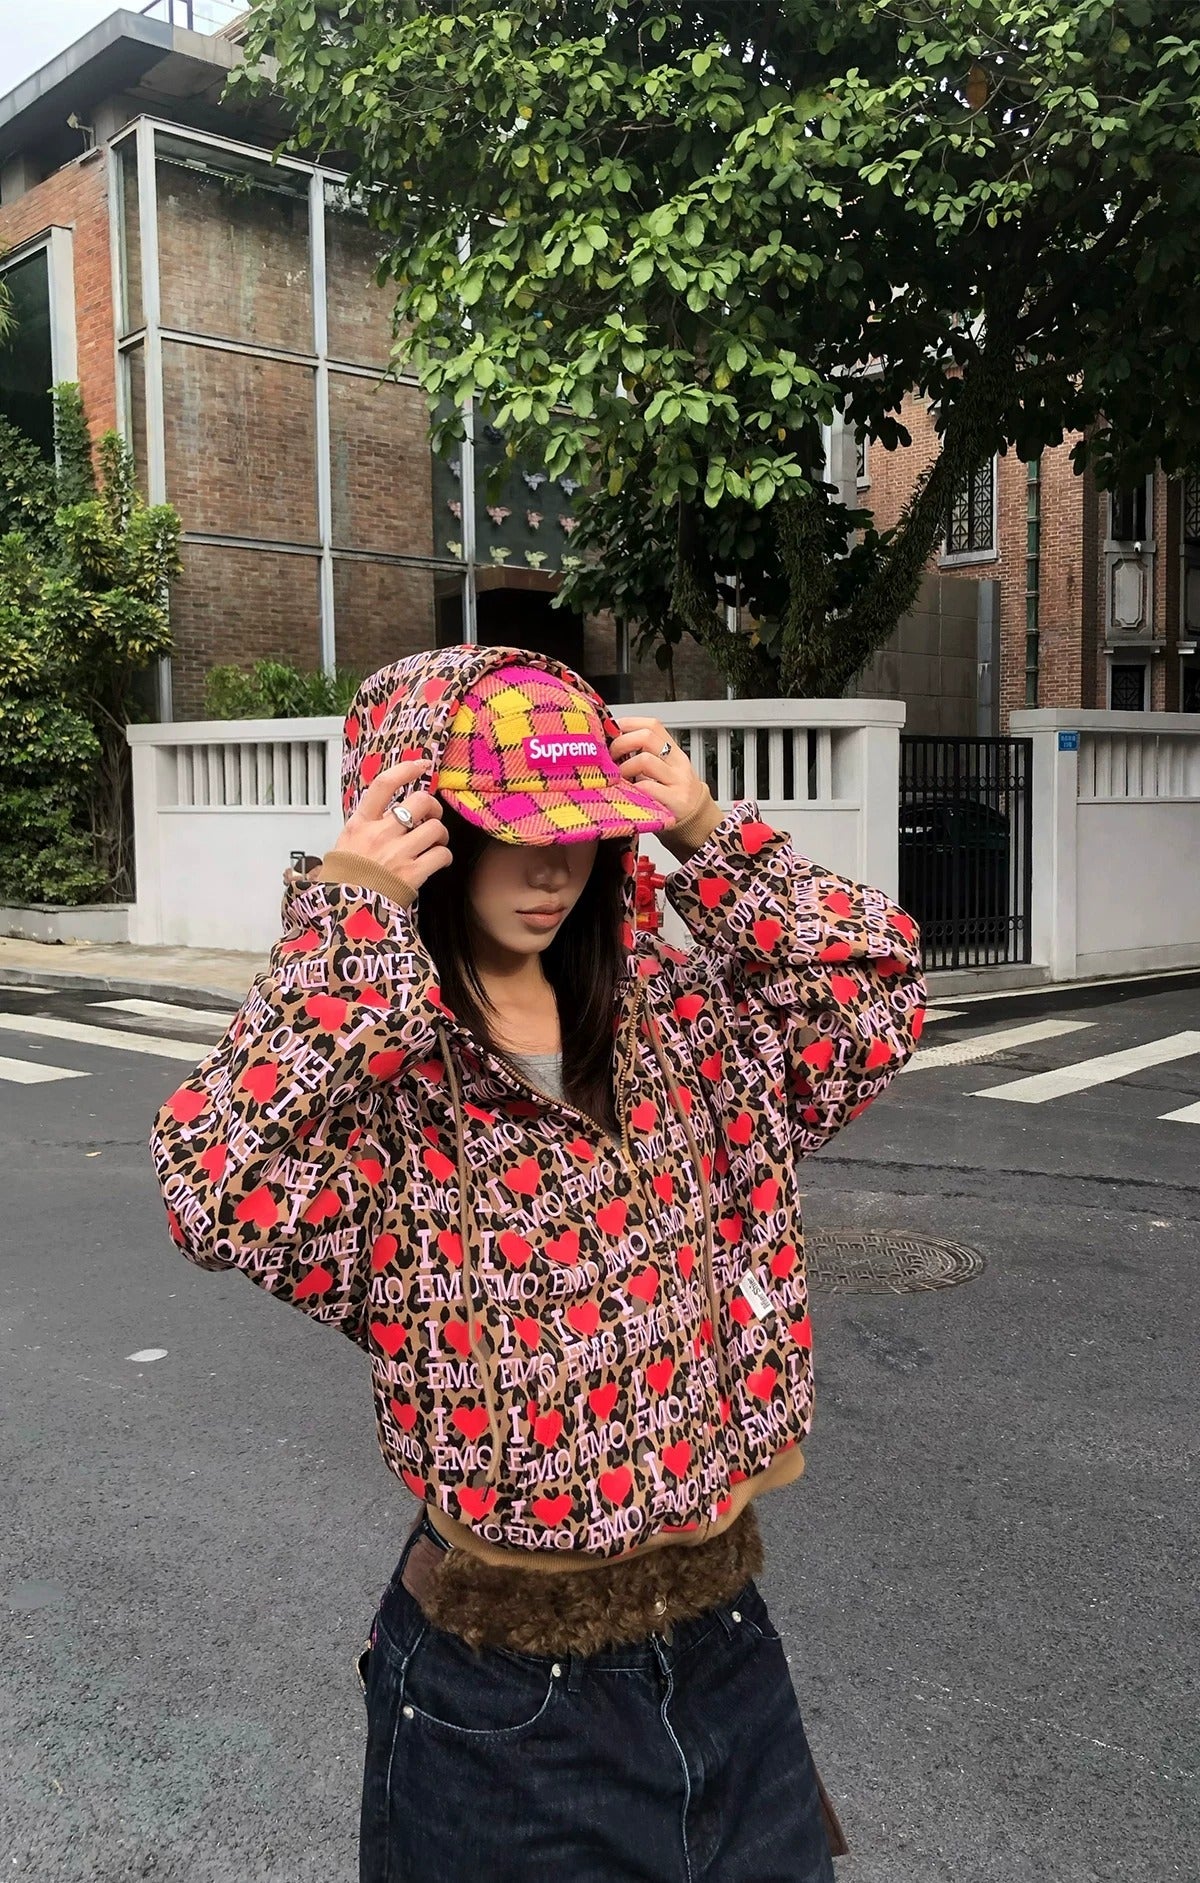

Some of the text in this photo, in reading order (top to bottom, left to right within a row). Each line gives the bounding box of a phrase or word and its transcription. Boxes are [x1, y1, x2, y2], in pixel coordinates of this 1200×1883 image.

[529, 738, 598, 763] Supreme
[713, 855, 744, 881] I
[767, 844, 793, 878] MO
[727, 878, 772, 932] EMO
[388, 915, 409, 941] I
[824, 924, 855, 941] I
[342, 953, 417, 984] EMO
[761, 978, 799, 1007] EM
[891, 978, 927, 1013] MO
[337, 1013, 376, 1050] I
[400, 1016, 438, 1058] MO
[657, 1014, 681, 1042] I
[886, 1027, 907, 1058] I
[269, 1026, 335, 1090] EMO
[833, 1038, 852, 1068] I
[266, 1081, 304, 1120] I
[709, 1078, 735, 1116] MO
[812, 1080, 849, 1101] EM
[857, 1068, 900, 1099] MO
[759, 1091, 781, 1123] I
[820, 1103, 839, 1128] I
[180, 1112, 217, 1141] I
[227, 1111, 265, 1165] EM
[309, 1110, 335, 1147] I
[788, 1121, 830, 1150] EM
[408, 1143, 424, 1179] I
[463, 1123, 523, 1171] EMO
[550, 1143, 574, 1177] I
[633, 1133, 667, 1165] MO
[731, 1141, 766, 1187] EMO
[214, 1157, 236, 1200] I
[259, 1154, 323, 1190] EMO
[562, 1161, 615, 1206] EMO
[681, 1160, 698, 1194] I
[165, 1173, 212, 1241] EMO
[338, 1172, 358, 1212] I
[410, 1183, 461, 1215] EMO
[485, 1178, 512, 1214] I
[281, 1193, 307, 1235] I
[505, 1191, 563, 1237] EMO
[752, 1208, 788, 1249] MO
[214, 1238, 290, 1271] EMO
[299, 1226, 362, 1265] EMO
[416, 1229, 434, 1269] I
[480, 1231, 495, 1270] I
[336, 1257, 354, 1292] I
[367, 1276, 404, 1304] MO
[481, 1273, 539, 1301] EMO
[550, 1261, 600, 1297] EMO
[306, 1302, 353, 1321] EM
[610, 1288, 635, 1316] I
[768, 1275, 807, 1312] MO
[425, 1320, 442, 1358] I
[499, 1314, 514, 1354] I
[551, 1308, 574, 1343] I
[727, 1325, 768, 1369] EMO
[425, 1362, 484, 1390] EMO
[787, 1353, 799, 1383] I
[631, 1368, 646, 1407] I
[433, 1407, 449, 1442] I
[508, 1405, 525, 1444] I
[574, 1393, 588, 1432] I
[633, 1395, 684, 1440] EMO
[741, 1399, 788, 1448] EMO
[382, 1421, 424, 1463] EMO
[432, 1445, 494, 1471] EMO
[576, 1420, 626, 1466] EMO
[643, 1451, 666, 1491] I
[510, 1500, 527, 1524] I
[586, 1478, 601, 1519] I
[652, 1479, 700, 1517] EMO
[503, 1525, 575, 1549] EMO
[587, 1505, 643, 1550] EMO
